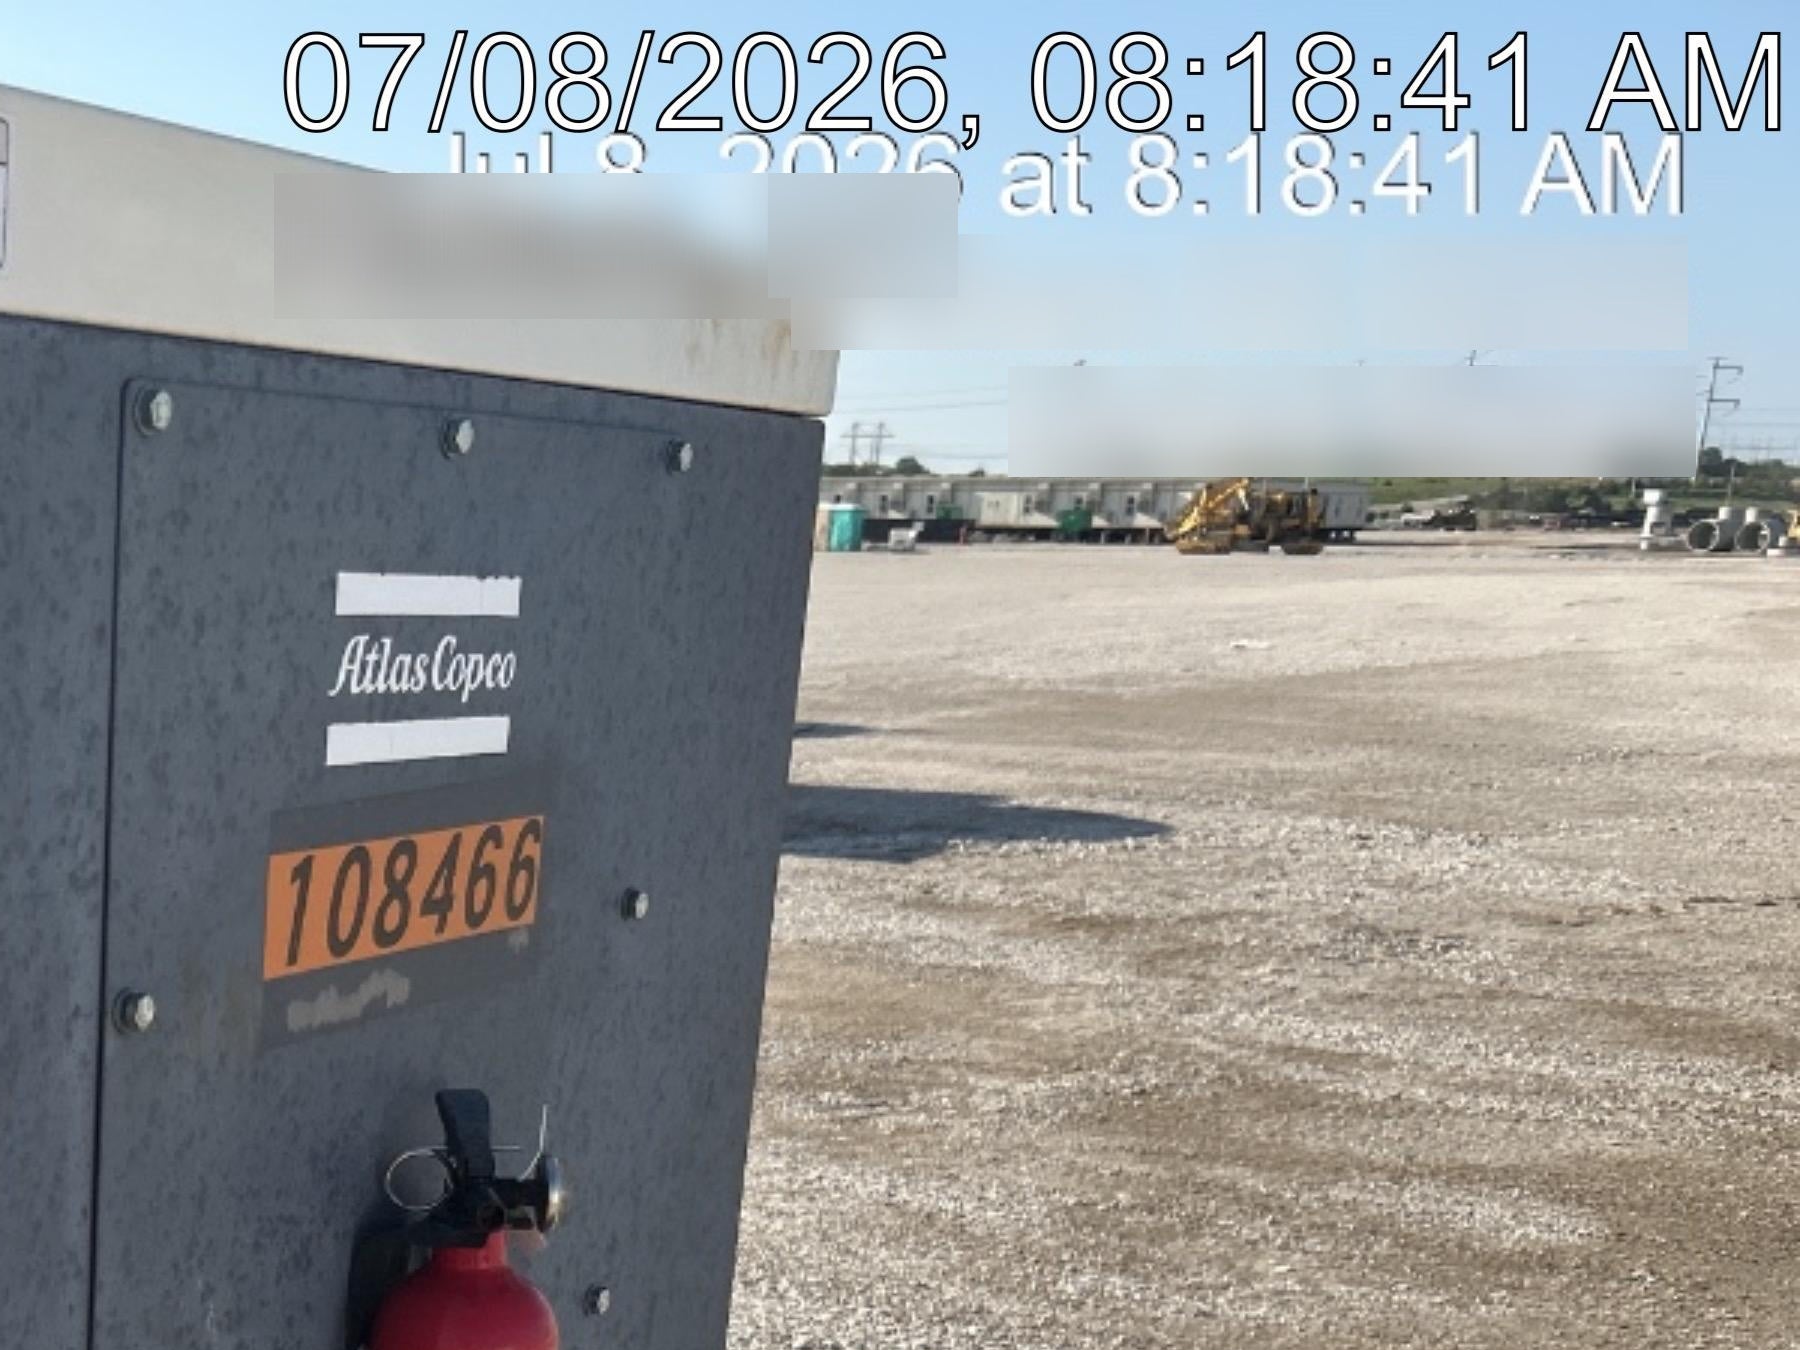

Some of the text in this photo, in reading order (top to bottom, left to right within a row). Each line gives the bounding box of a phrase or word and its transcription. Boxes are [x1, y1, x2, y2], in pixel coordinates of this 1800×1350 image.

[328, 634, 516, 702] Atlas Copco
[287, 818, 542, 966] 108466
